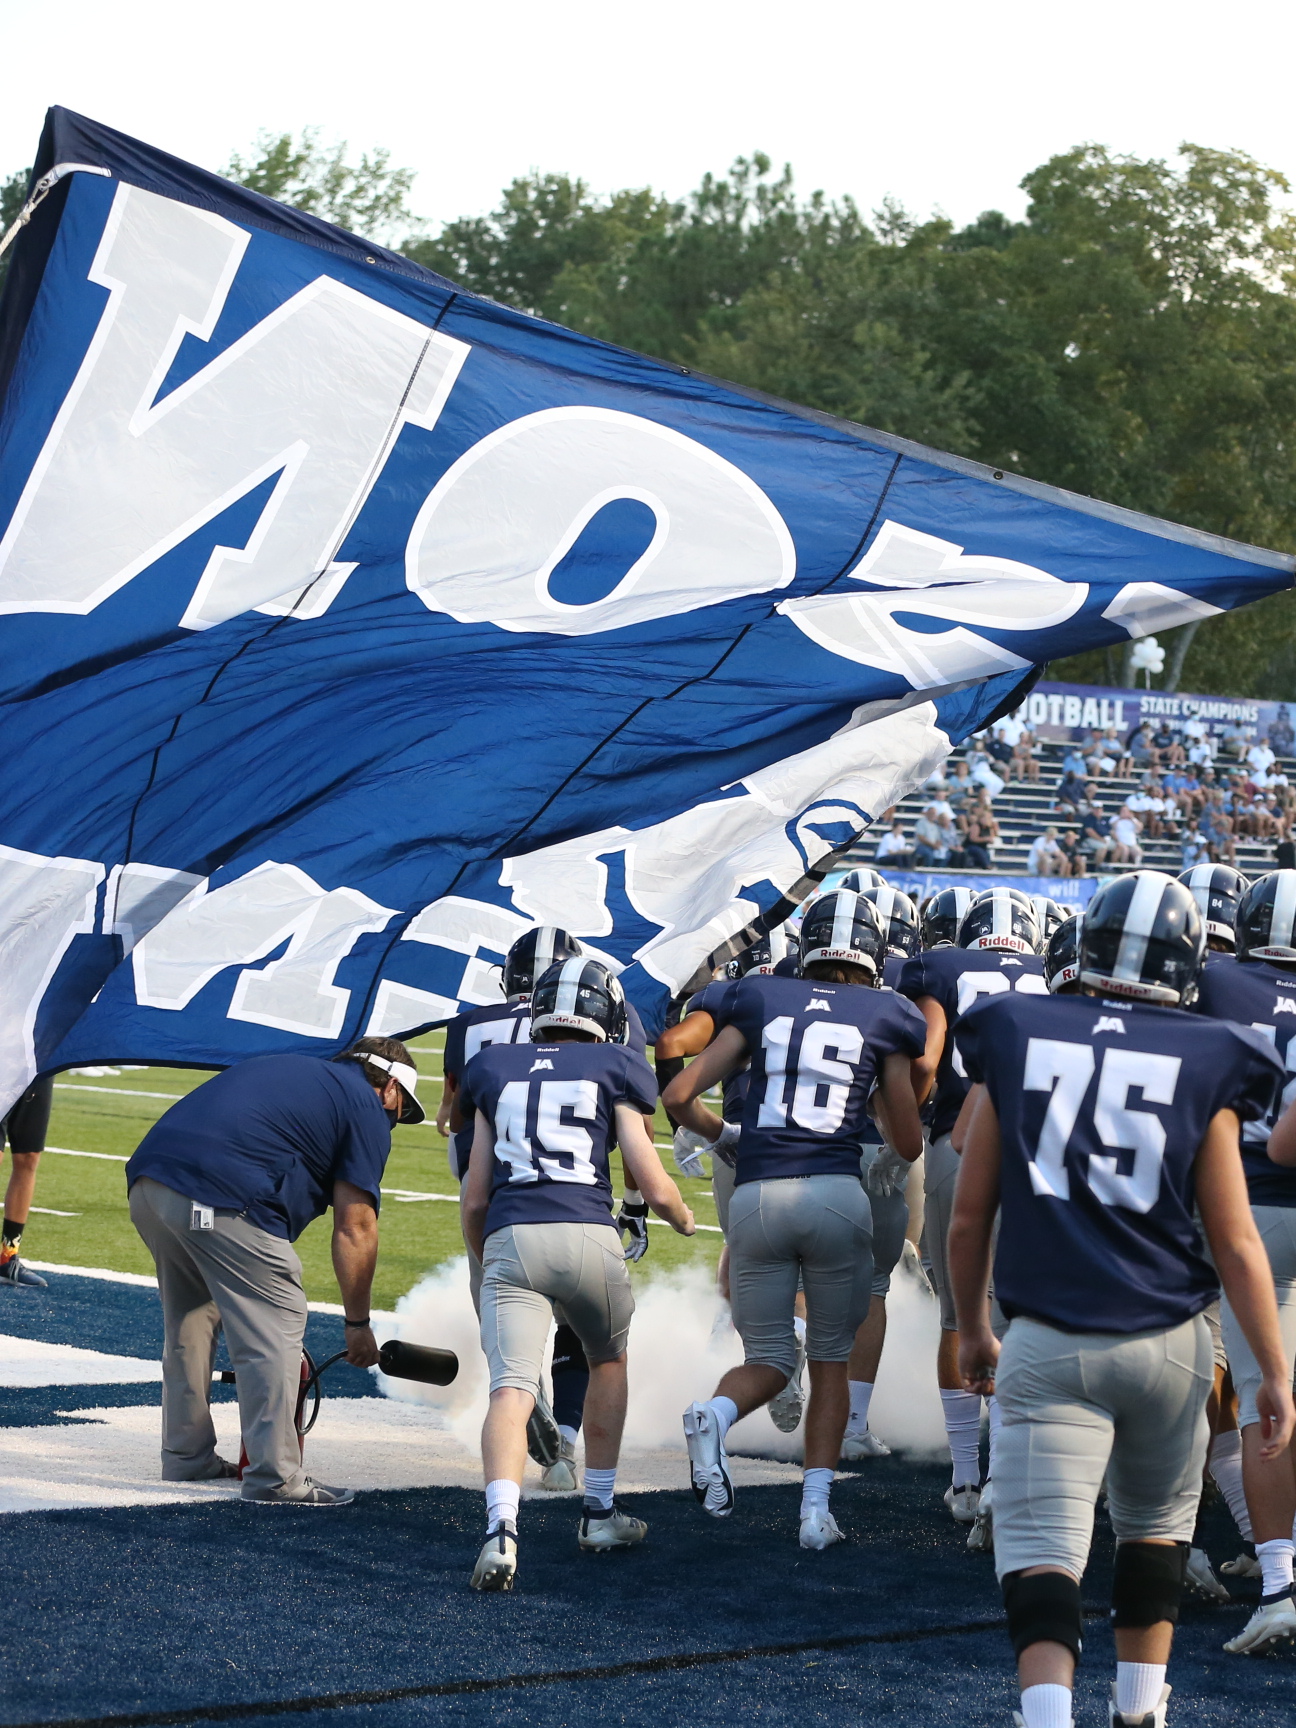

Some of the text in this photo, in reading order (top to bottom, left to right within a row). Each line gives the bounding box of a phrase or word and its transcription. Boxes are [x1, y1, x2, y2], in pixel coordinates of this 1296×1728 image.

[1140, 696, 1180, 715] STATE
[1048, 879, 1080, 898] will
[978, 936, 1025, 951] Riddell
[820, 949, 861, 961] Riddell
[579, 989, 591, 999] 45
[757, 1015, 865, 1135] 16
[494, 1079, 600, 1186] 45
[1023, 1037, 1183, 1215] 75
